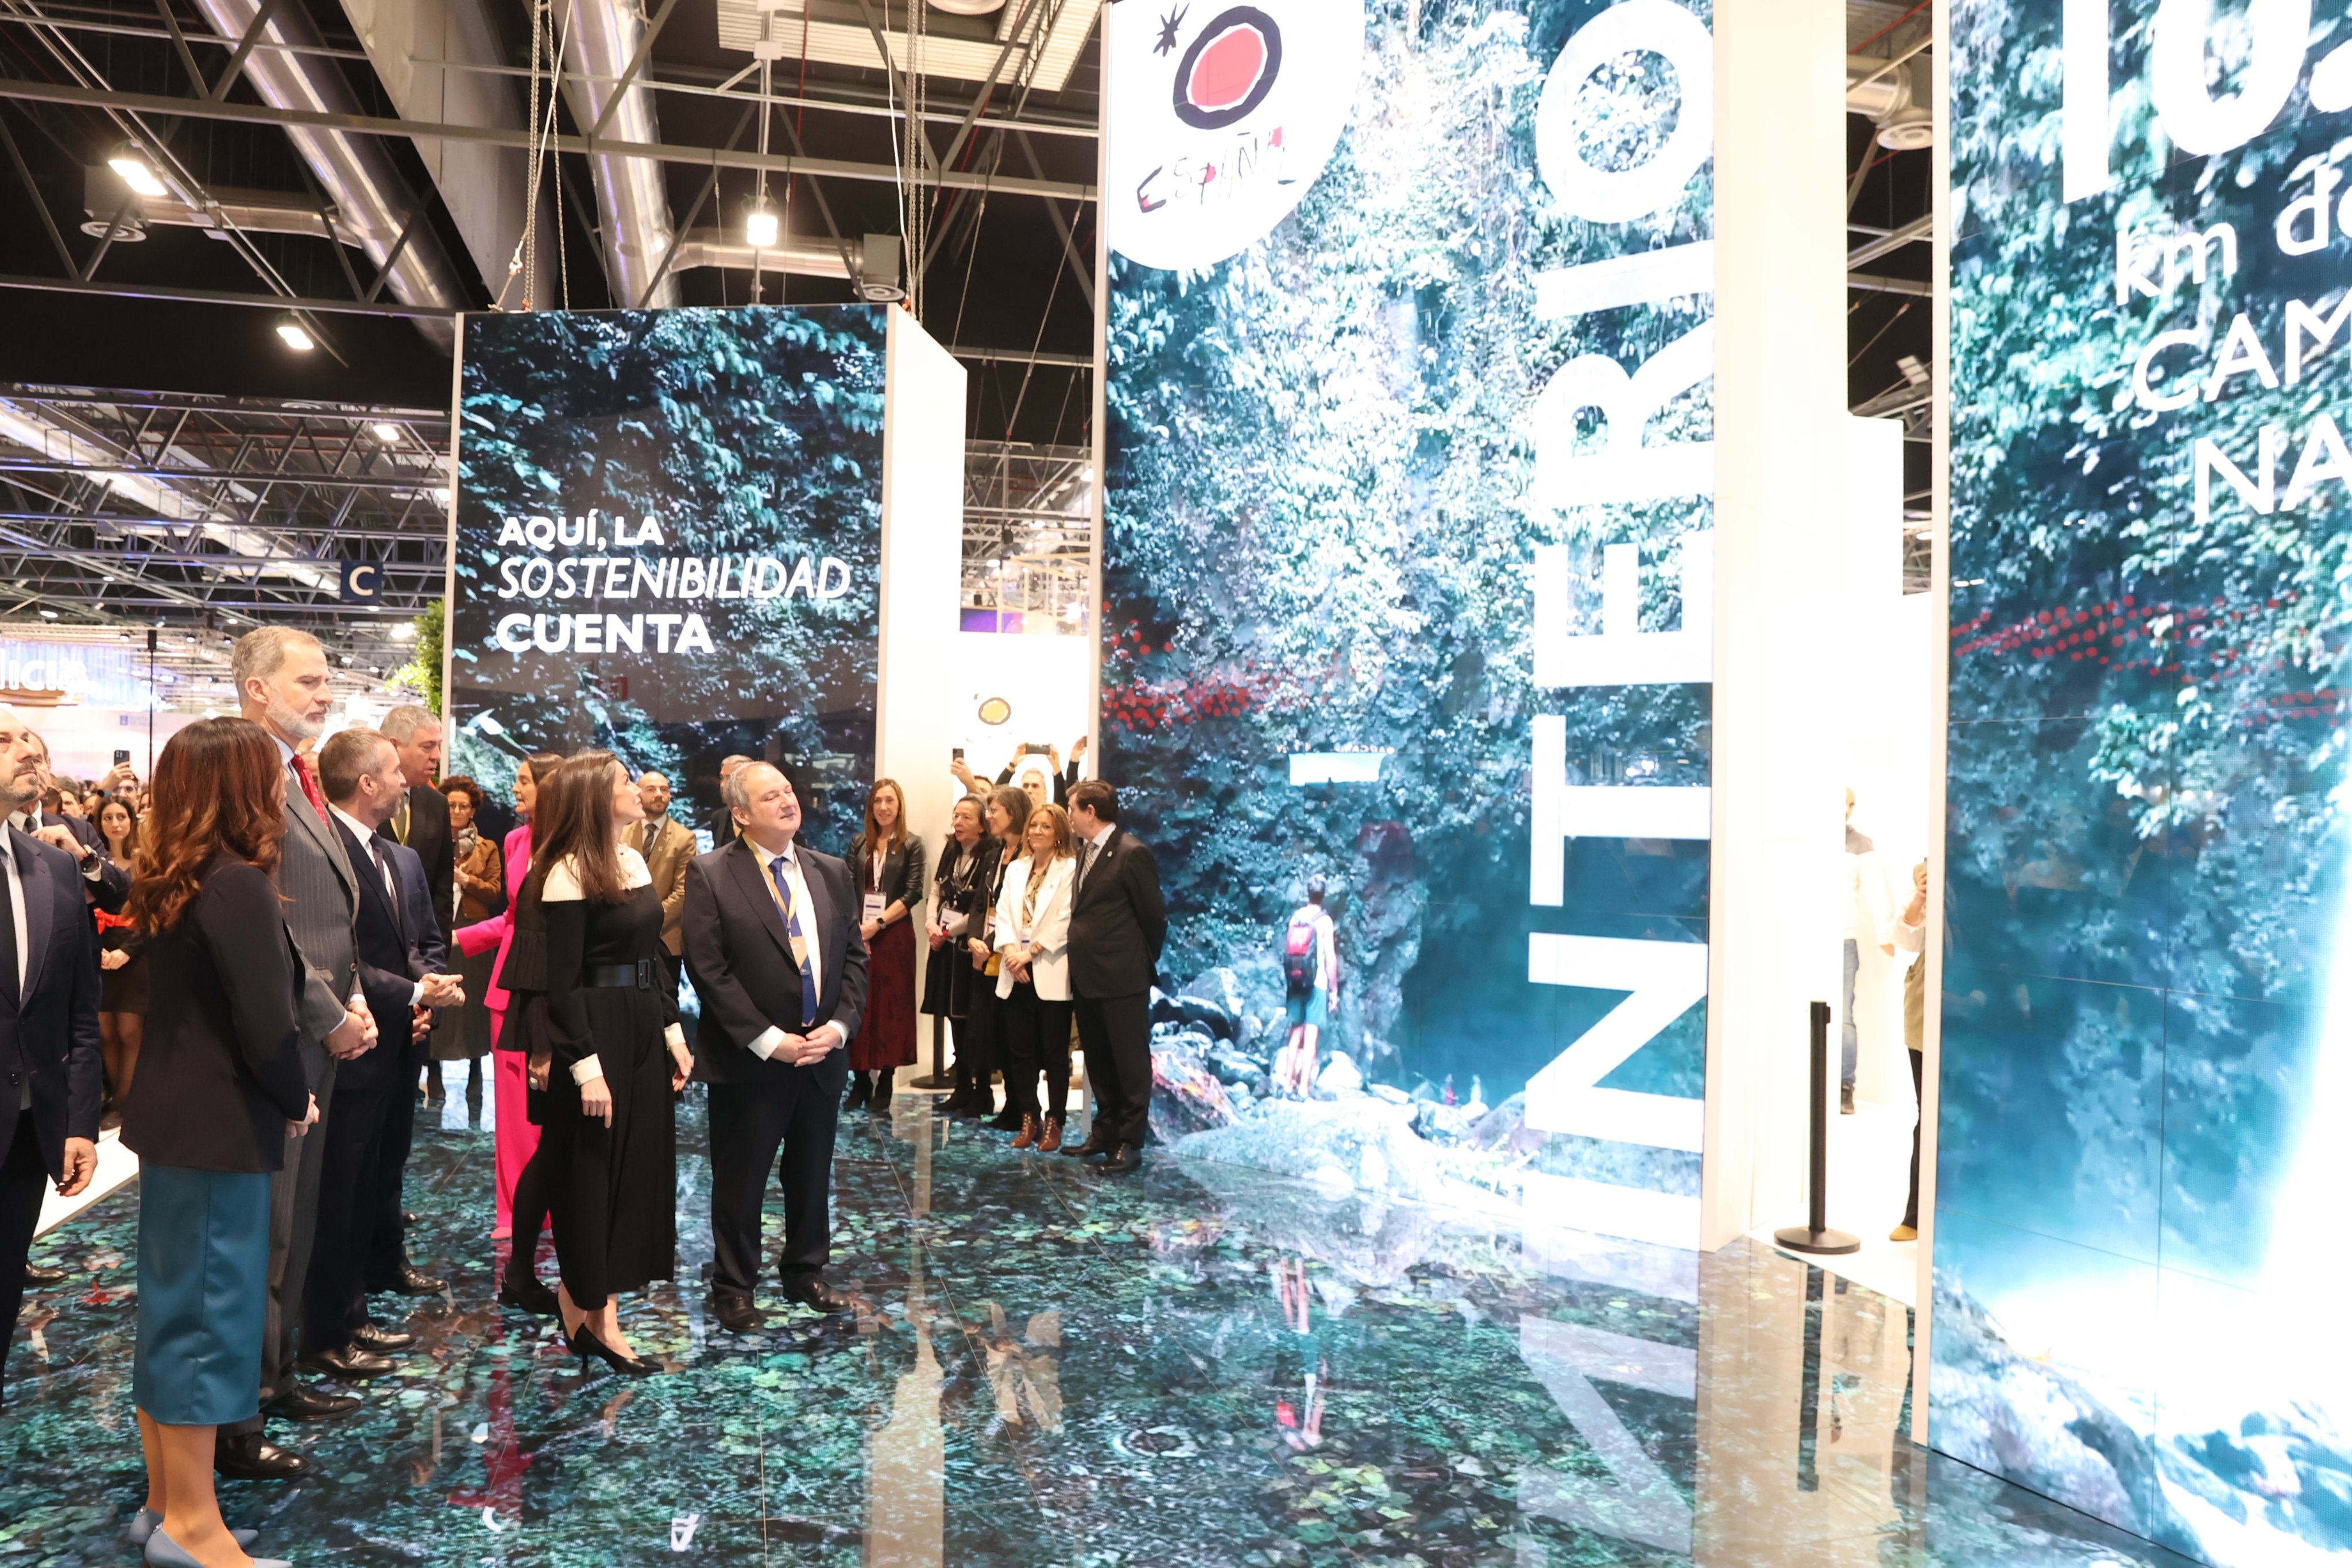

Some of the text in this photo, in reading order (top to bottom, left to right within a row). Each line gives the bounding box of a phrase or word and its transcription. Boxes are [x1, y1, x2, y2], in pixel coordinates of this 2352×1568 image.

[2115, 220, 2237, 306] km
[2133, 289, 2352, 412] CAM
[2194, 413, 2352, 525] NA
[497, 509, 664, 552] AQUÍ, LA
[349, 566, 374, 596] C
[498, 556, 852, 599] SOSTENIBILIDAD
[496, 613, 715, 653] CUENTA
